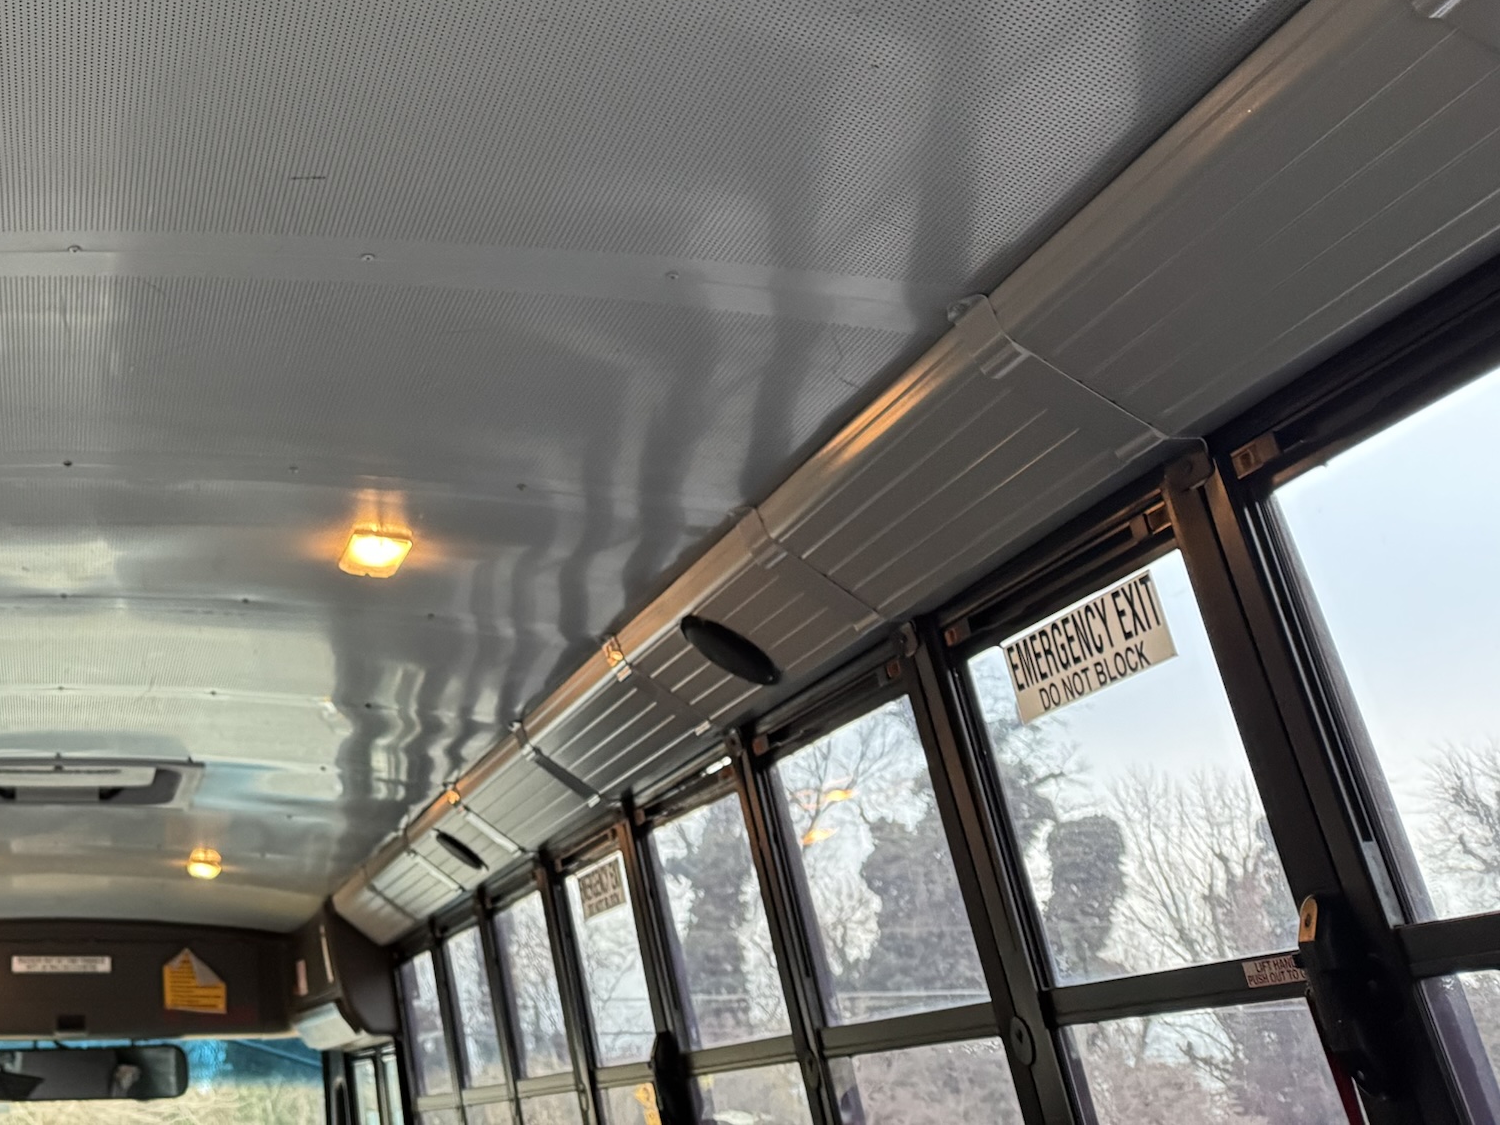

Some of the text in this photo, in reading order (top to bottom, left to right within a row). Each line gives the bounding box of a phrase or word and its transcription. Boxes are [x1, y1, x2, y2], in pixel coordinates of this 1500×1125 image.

[1006, 575, 1162, 693] EMERGENCY EXIT
[1039, 640, 1152, 712] DO NOT BLOCK
[1247, 974, 1270, 986] PUSH
[1269, 970, 1286, 984] OUT
[1286, 969, 1300, 980] TO
